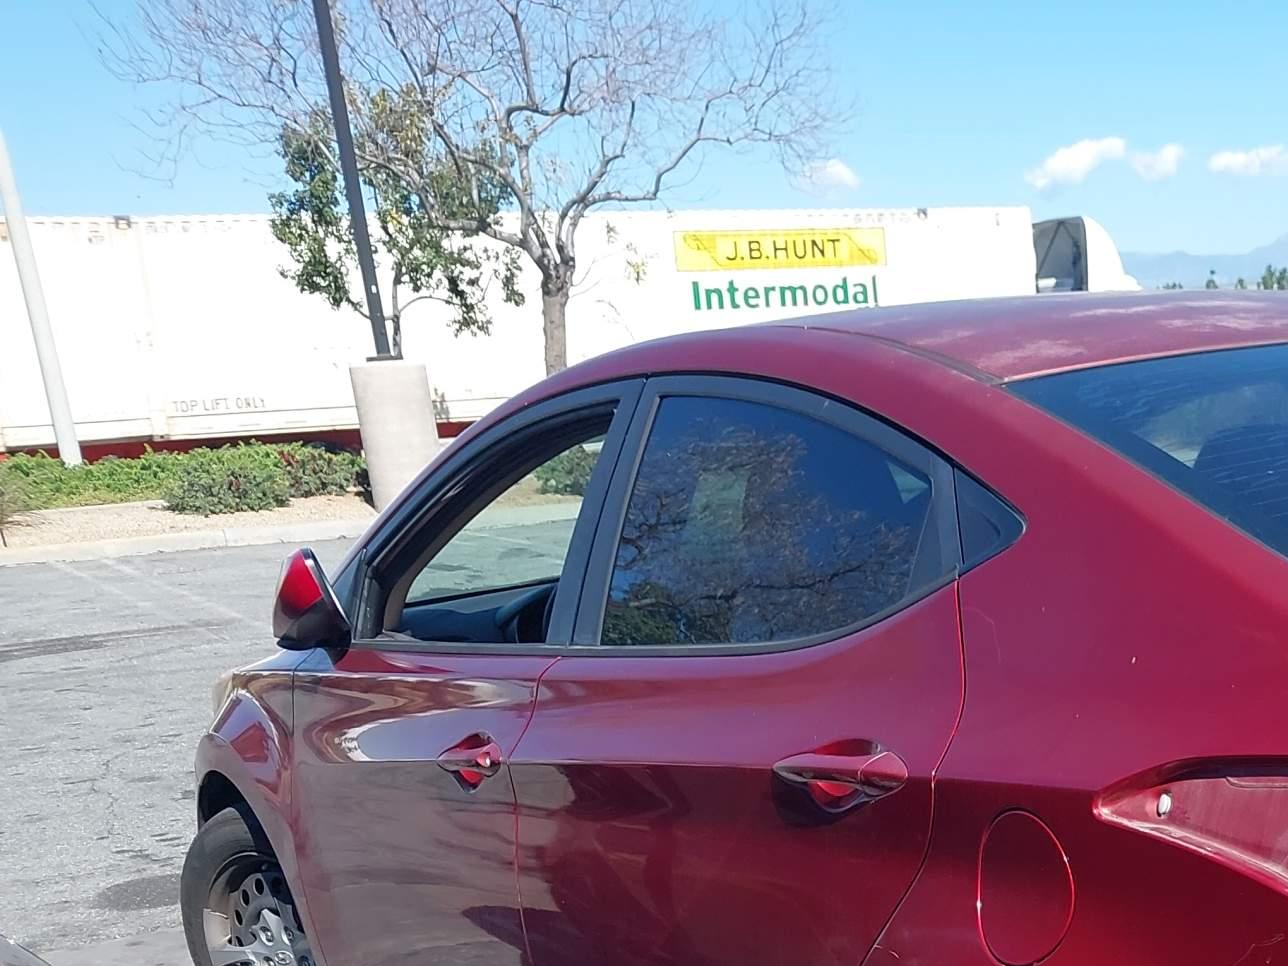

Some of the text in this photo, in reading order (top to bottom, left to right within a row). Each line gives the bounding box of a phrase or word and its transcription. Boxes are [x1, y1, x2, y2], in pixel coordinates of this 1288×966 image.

[691, 275, 879, 311] Intermodal
[172, 396, 266, 413] TOP LIFT ONLY
